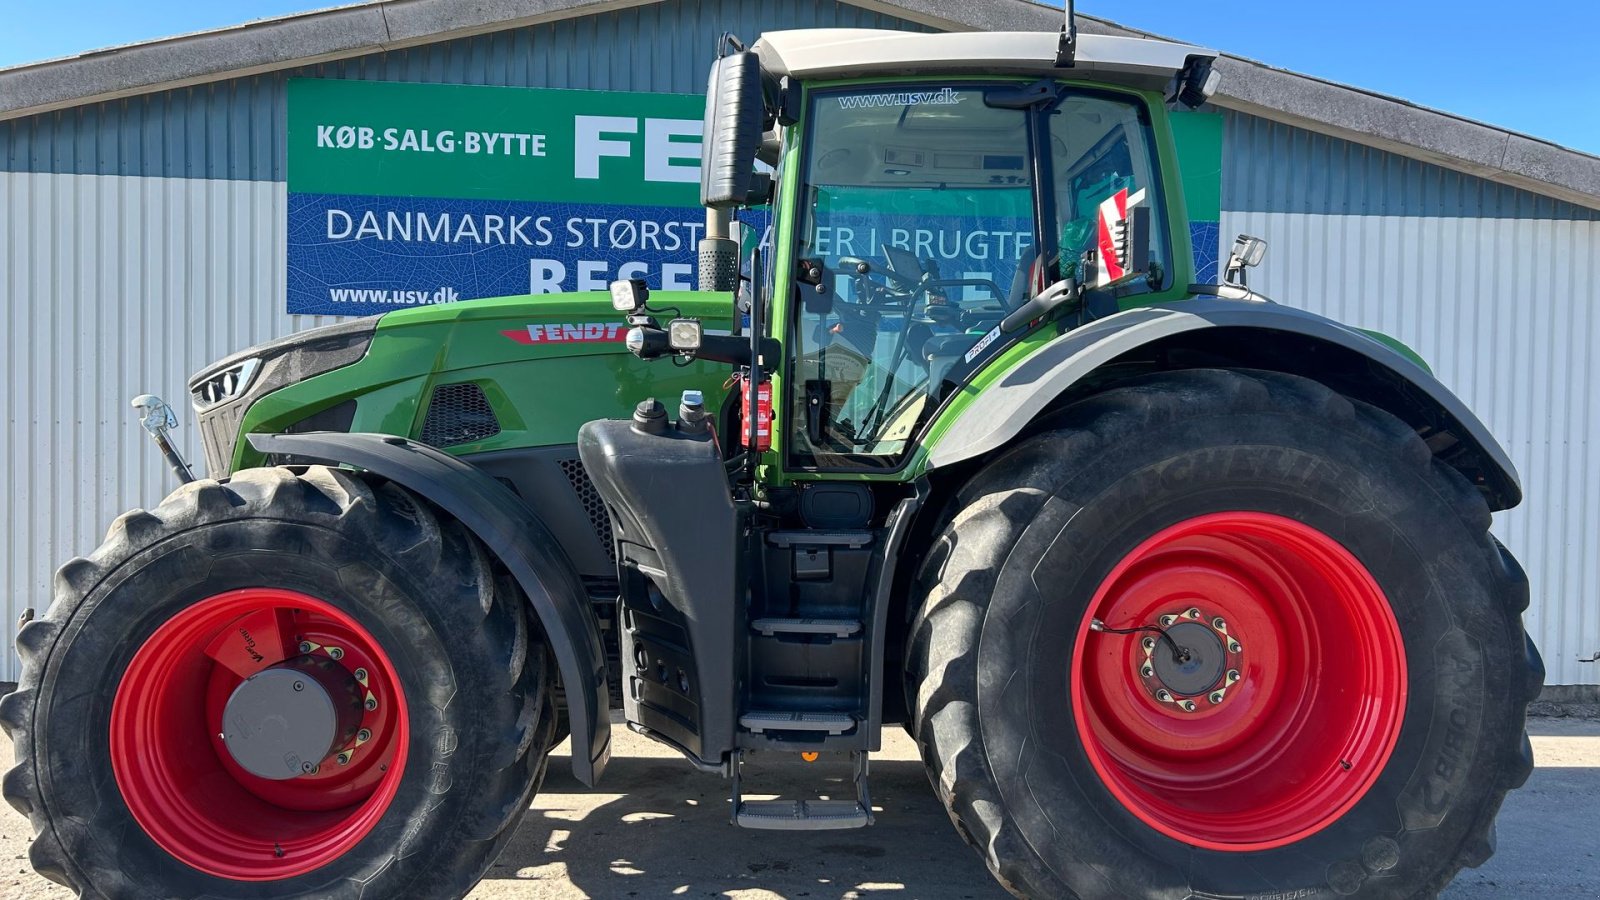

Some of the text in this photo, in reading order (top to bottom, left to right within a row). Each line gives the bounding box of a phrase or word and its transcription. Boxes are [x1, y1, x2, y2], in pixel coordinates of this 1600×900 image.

[838, 88, 960, 110] www.usv.dk
[574, 114, 704, 183] FE
[326, 208, 554, 247] DANMARKS
[566, 216, 705, 252] STØRST
[329, 286, 459, 305] www.usv.dk
[526, 322, 624, 341] FENDT
